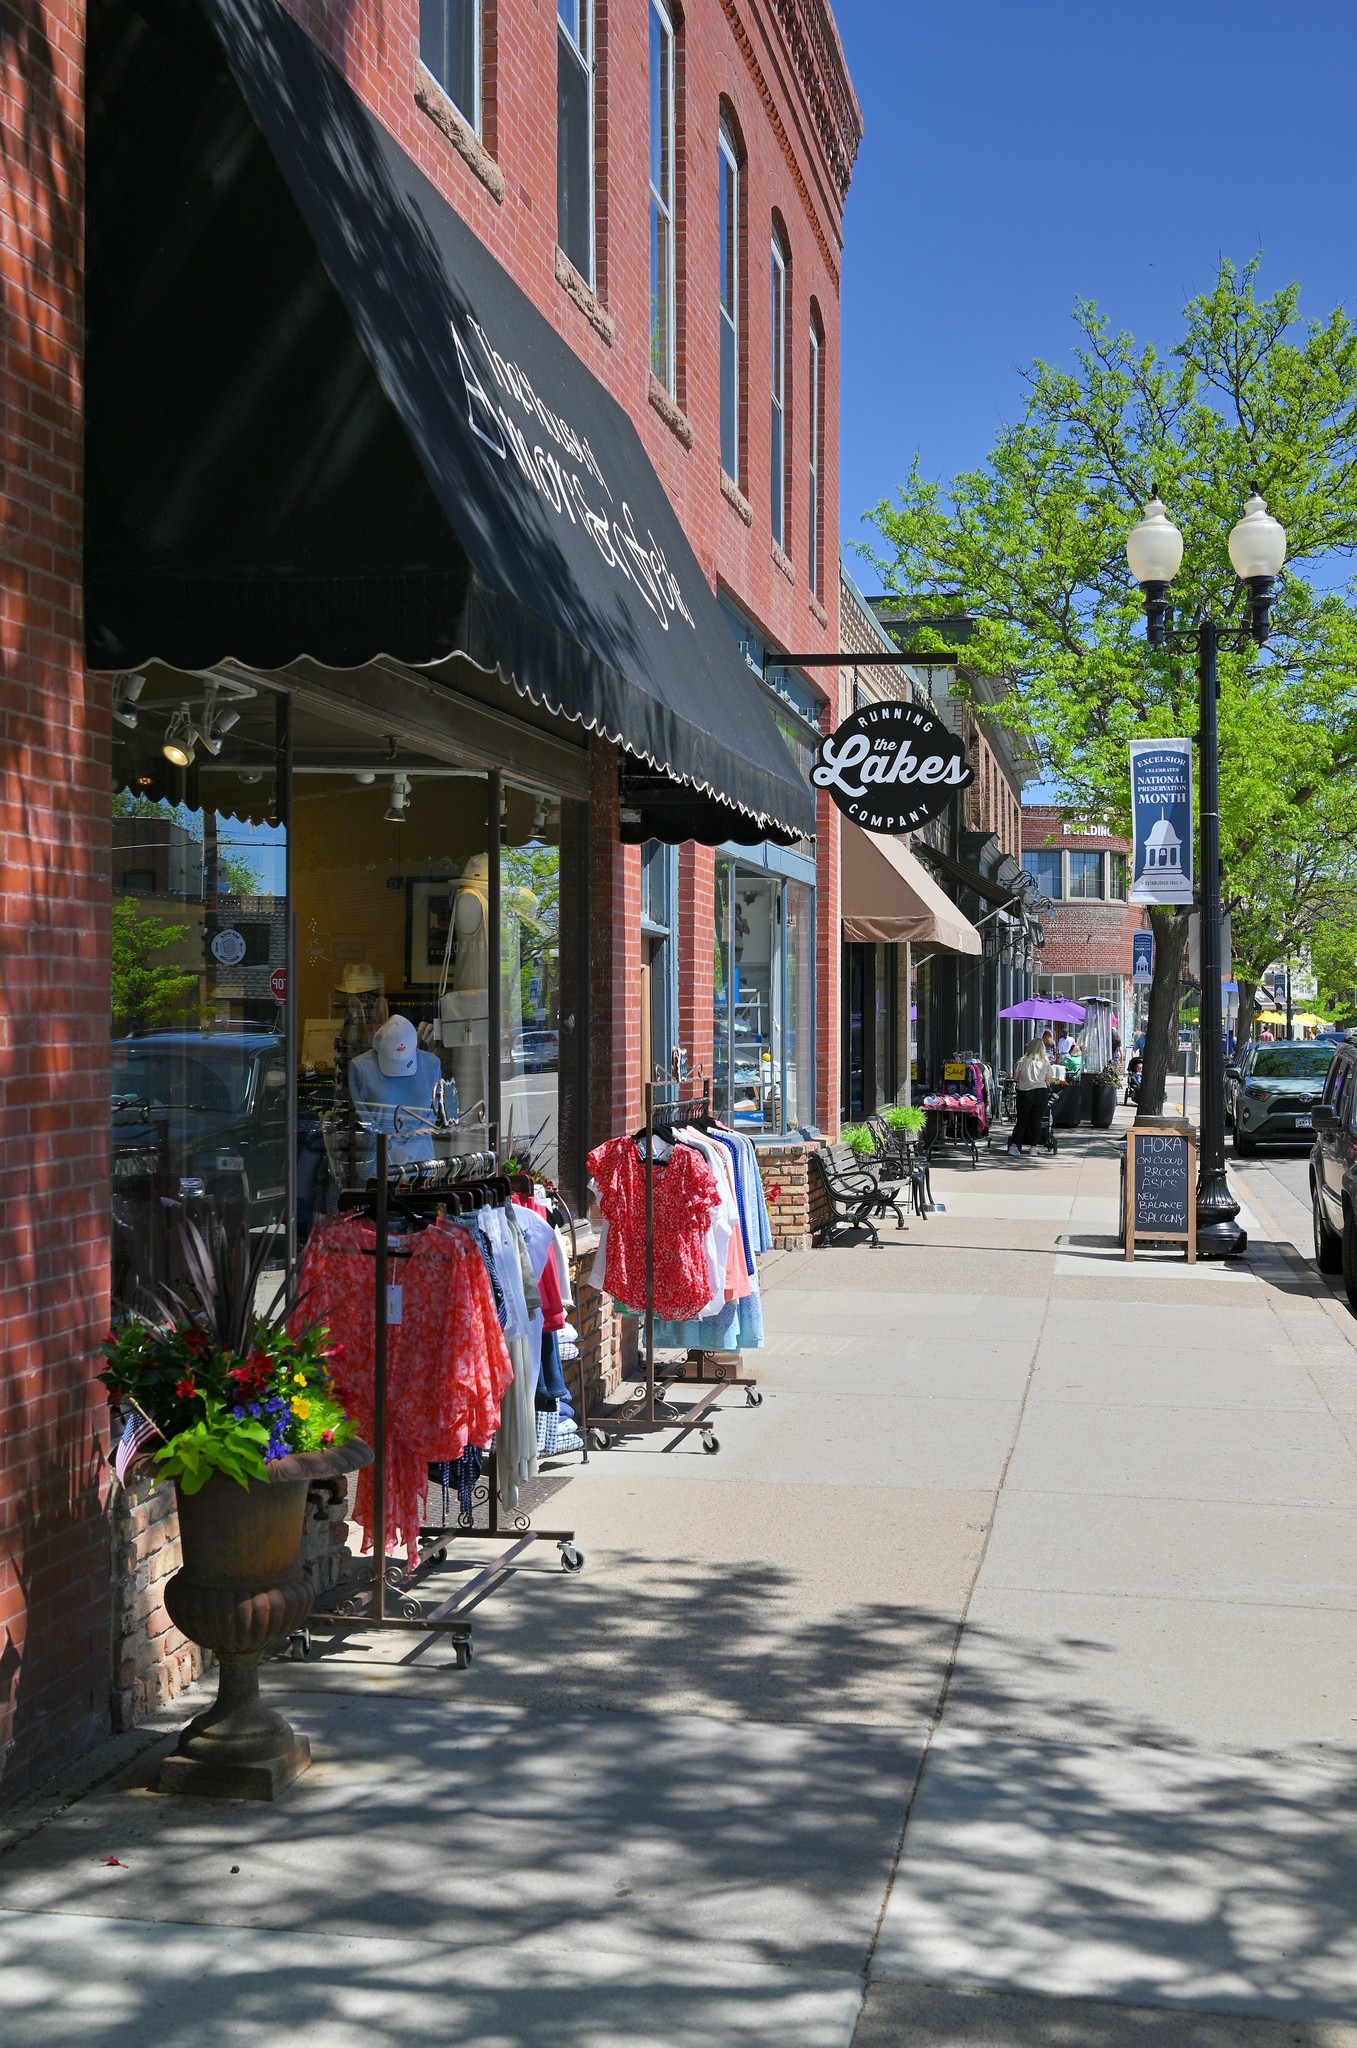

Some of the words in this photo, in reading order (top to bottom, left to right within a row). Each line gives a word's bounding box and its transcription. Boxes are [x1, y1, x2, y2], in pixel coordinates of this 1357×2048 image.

[450, 321, 593, 534] Amore
[858, 708, 933, 733] RUNNING
[874, 738, 897, 751] the
[813, 733, 970, 798] Lakes
[1137, 756, 1186, 768] EXCELSIOR
[1138, 776, 1186, 784] NATIONAL
[1138, 793, 1186, 804] MONTH
[849, 804, 929, 827] COMPANY
[946, 1066, 964, 1076] SALE
[1142, 1137, 1182, 1154] HOKA
[1153, 1157, 1183, 1165] CLOUD
[1144, 1166, 1186, 1178] BROOKS
[1142, 1178, 1178, 1190] ASICS
[1138, 1192, 1158, 1200] NEW
